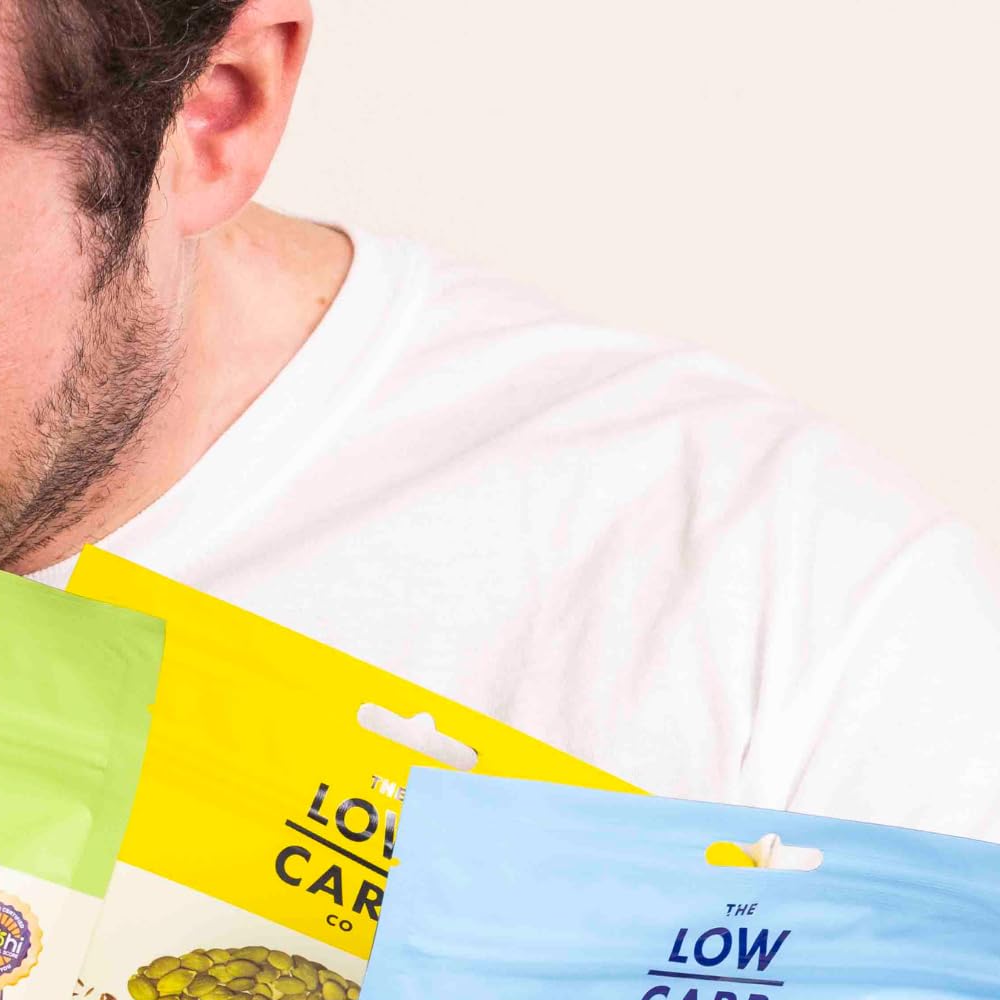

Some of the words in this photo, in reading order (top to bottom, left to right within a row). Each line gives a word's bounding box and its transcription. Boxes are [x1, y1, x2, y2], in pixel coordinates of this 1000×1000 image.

[726, 903, 758, 917] THE
[326, 914, 353, 932] CO
[668, 927, 791, 971] LOW
